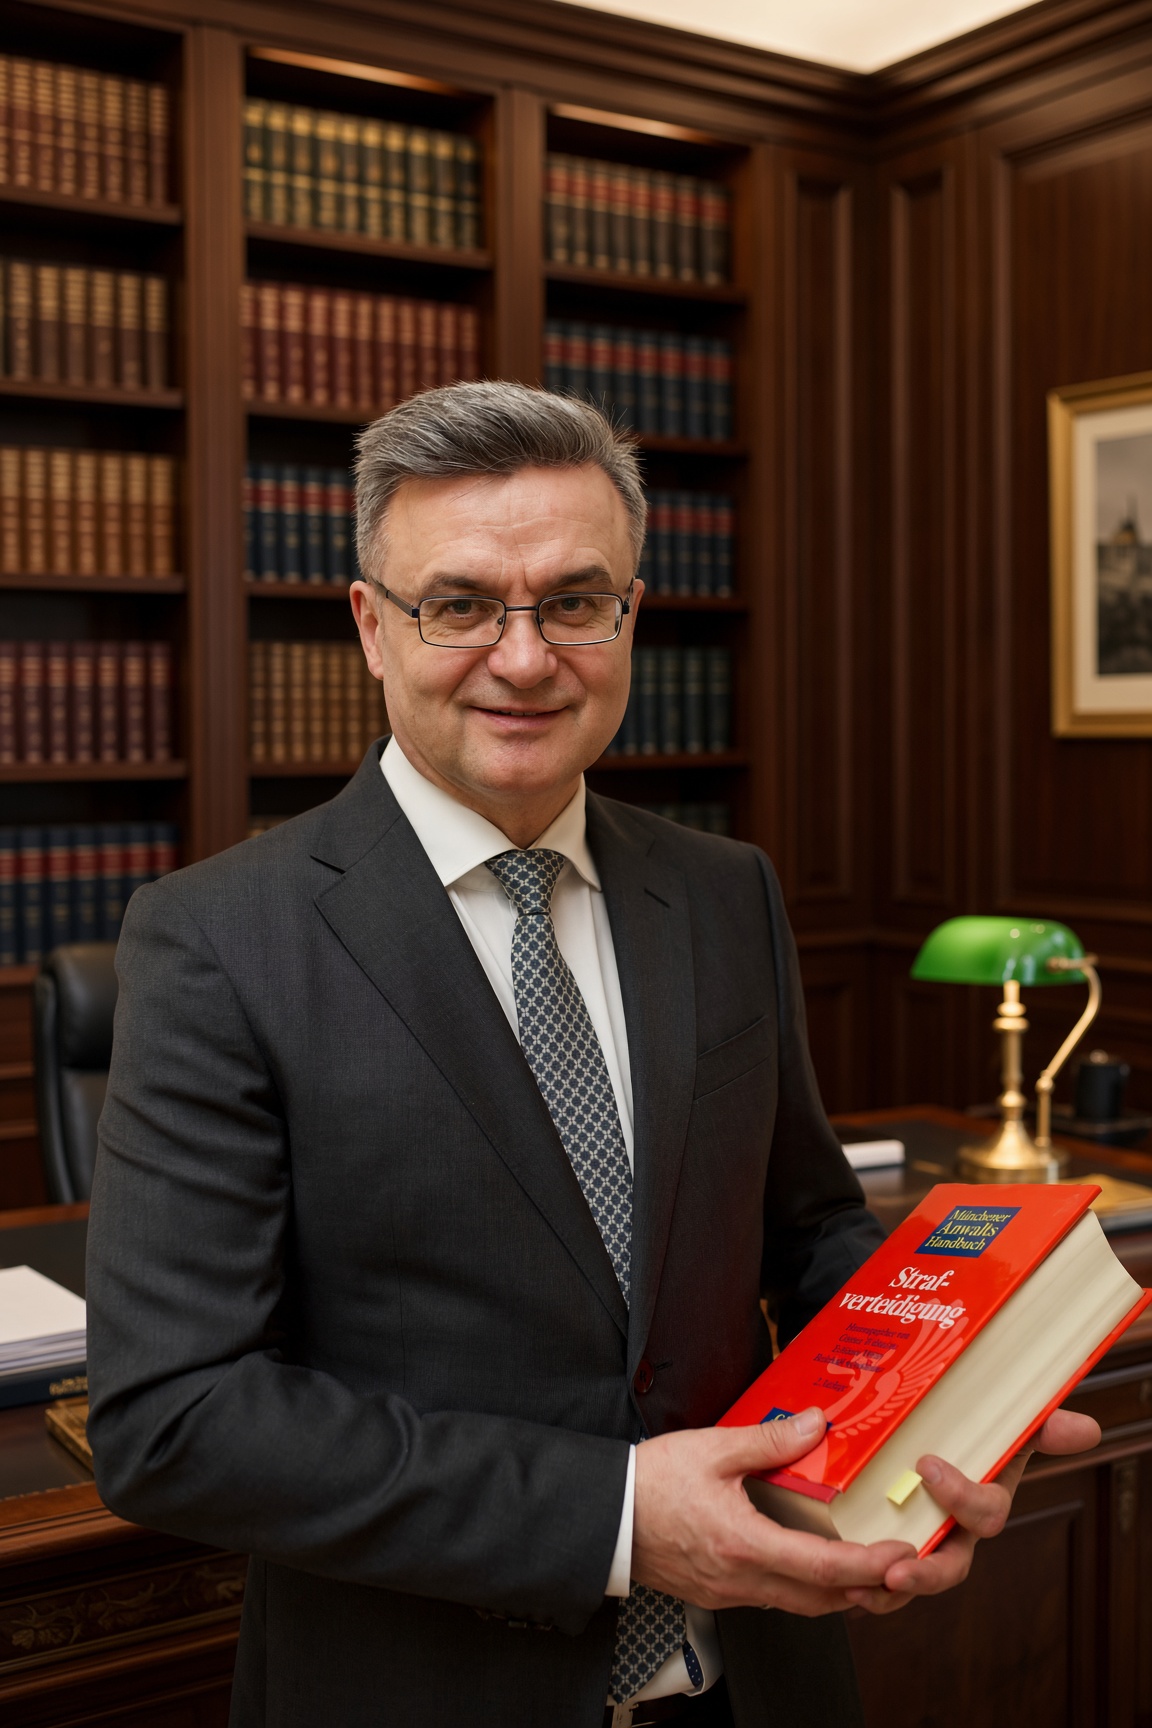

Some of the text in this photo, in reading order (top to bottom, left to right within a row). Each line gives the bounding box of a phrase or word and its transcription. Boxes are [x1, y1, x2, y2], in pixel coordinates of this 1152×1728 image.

[948, 1209, 1012, 1222] Münchener
[924, 1235, 986, 1250] Handbuch
[888, 1266, 955, 1291] Straf-
[839, 1293, 966, 1329] verteidigung
